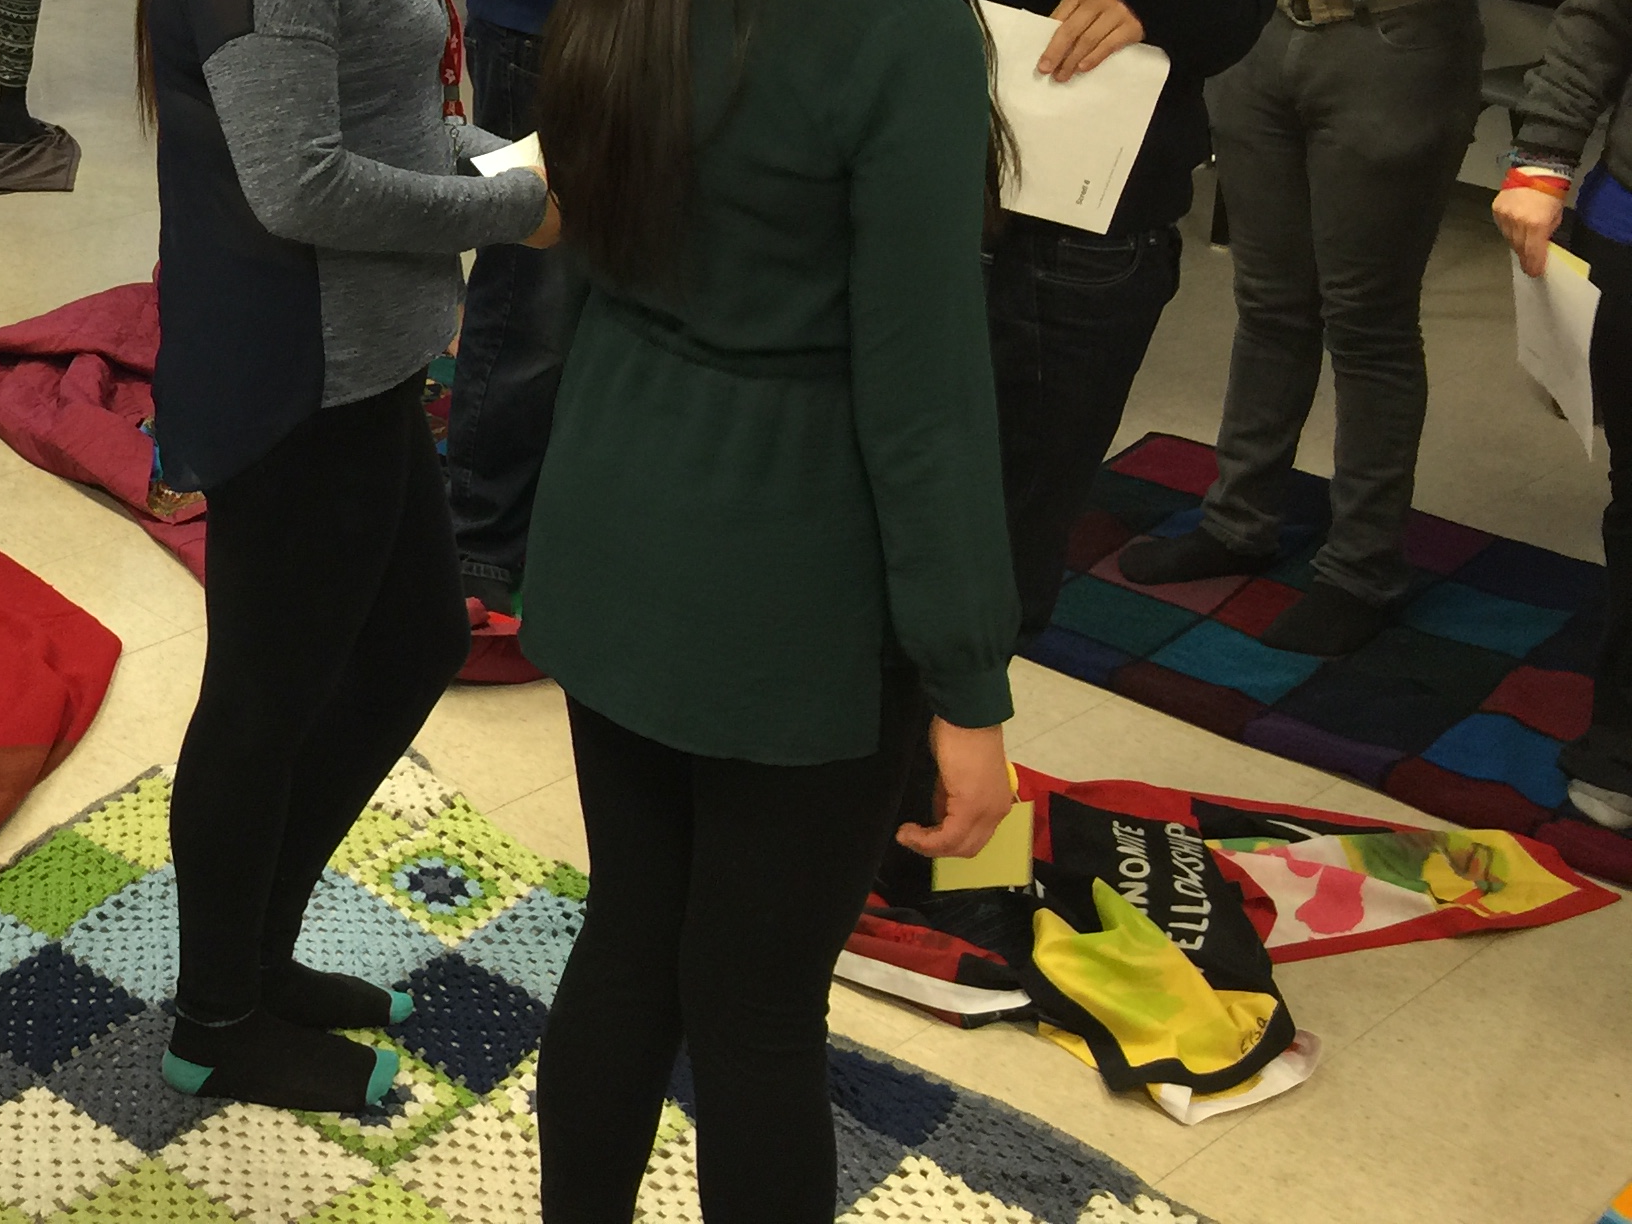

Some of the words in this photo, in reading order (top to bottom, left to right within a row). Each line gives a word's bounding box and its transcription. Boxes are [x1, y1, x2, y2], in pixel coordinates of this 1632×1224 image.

[1112, 820, 1151, 916] NONITE
[1164, 822, 1212, 951] ELLOWSHIP
[1239, 1016, 1268, 1055] Elsa
